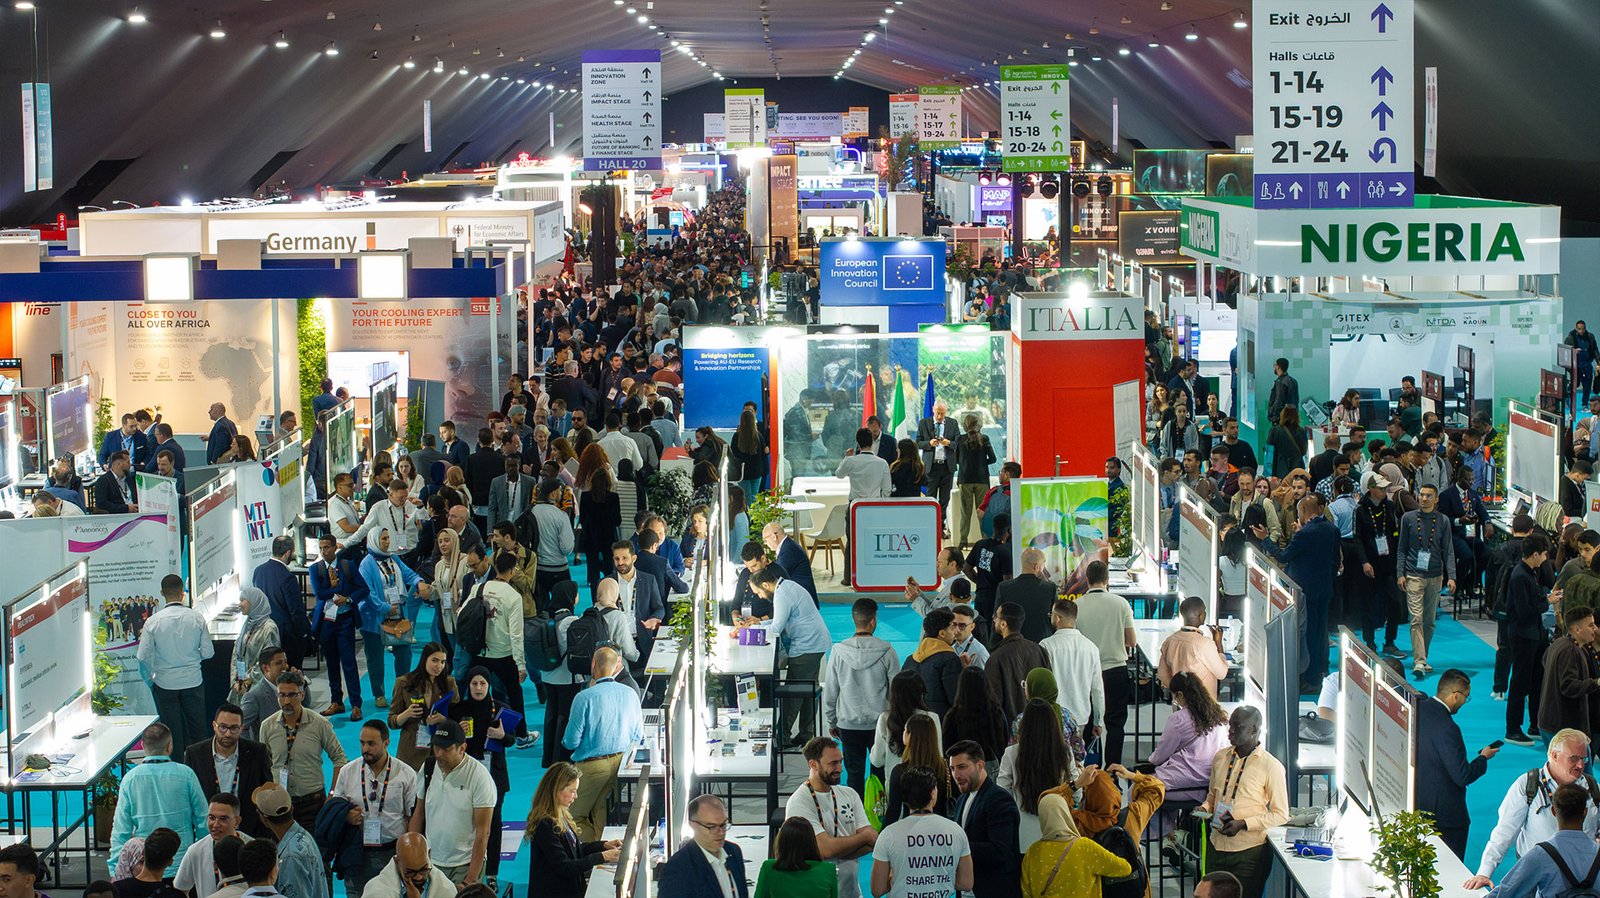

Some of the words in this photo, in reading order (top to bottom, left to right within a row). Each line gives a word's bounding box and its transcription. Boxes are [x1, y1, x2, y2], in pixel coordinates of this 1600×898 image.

[1269, 12, 1300, 26] Exit
[1306, 12, 1350, 27] الخروج
[1269, 51, 1298, 61] Halls
[1302, 51, 1335, 61] قاعات
[1269, 70, 1325, 94] 1-14
[1008, 111, 1032, 121] 1-14
[1269, 105, 1343, 129] 15-19
[923, 121, 943, 129] 15-17
[1008, 126, 1040, 137] 15-18
[1009, 142, 1047, 153] 20-24
[1271, 140, 1349, 163] 21-24
[598, 159, 630, 169] HALL
[631, 159, 647, 169] 20
[771, 165, 791, 178] IMPACT
[493, 223, 514, 232] Ministry
[1188, 211, 1216, 252] NIGERIA
[267, 232, 358, 253] Germany
[1300, 221, 1527, 264] NIGERIA
[835, 258, 878, 269] European
[831, 269, 878, 278] Innovation
[844, 279, 878, 288] Council
[25, 304, 51, 316] line
[127, 310, 160, 319] CLOSE
[161, 310, 175, 319] TO
[176, 310, 197, 319] YOU
[352, 309, 379, 317] YOUR
[380, 308, 425, 317] COOLING
[426, 308, 464, 317] EXPERT
[352, 318, 372, 327] FOR
[373, 318, 393, 327] THE
[394, 318, 432, 327] FUTURE
[1027, 306, 1138, 332] ITALIA
[1335, 313, 1370, 322] GITEX
[127, 320, 145, 328] ALL
[146, 320, 173, 328] OVER
[174, 319, 211, 328] AFRICA
[701, 352, 728, 360] Bridging
[243, 501, 271, 523] MTL
[246, 519, 273, 542] INTL
[874, 533, 912, 552] ITA
[907, 834, 925, 847] DO
[928, 833, 953, 847] YOU
[908, 855, 954, 869] WANNA
[905, 875, 935, 886] SHARE
[936, 874, 951, 883] THE
[907, 889, 950, 898] ENERGY?
